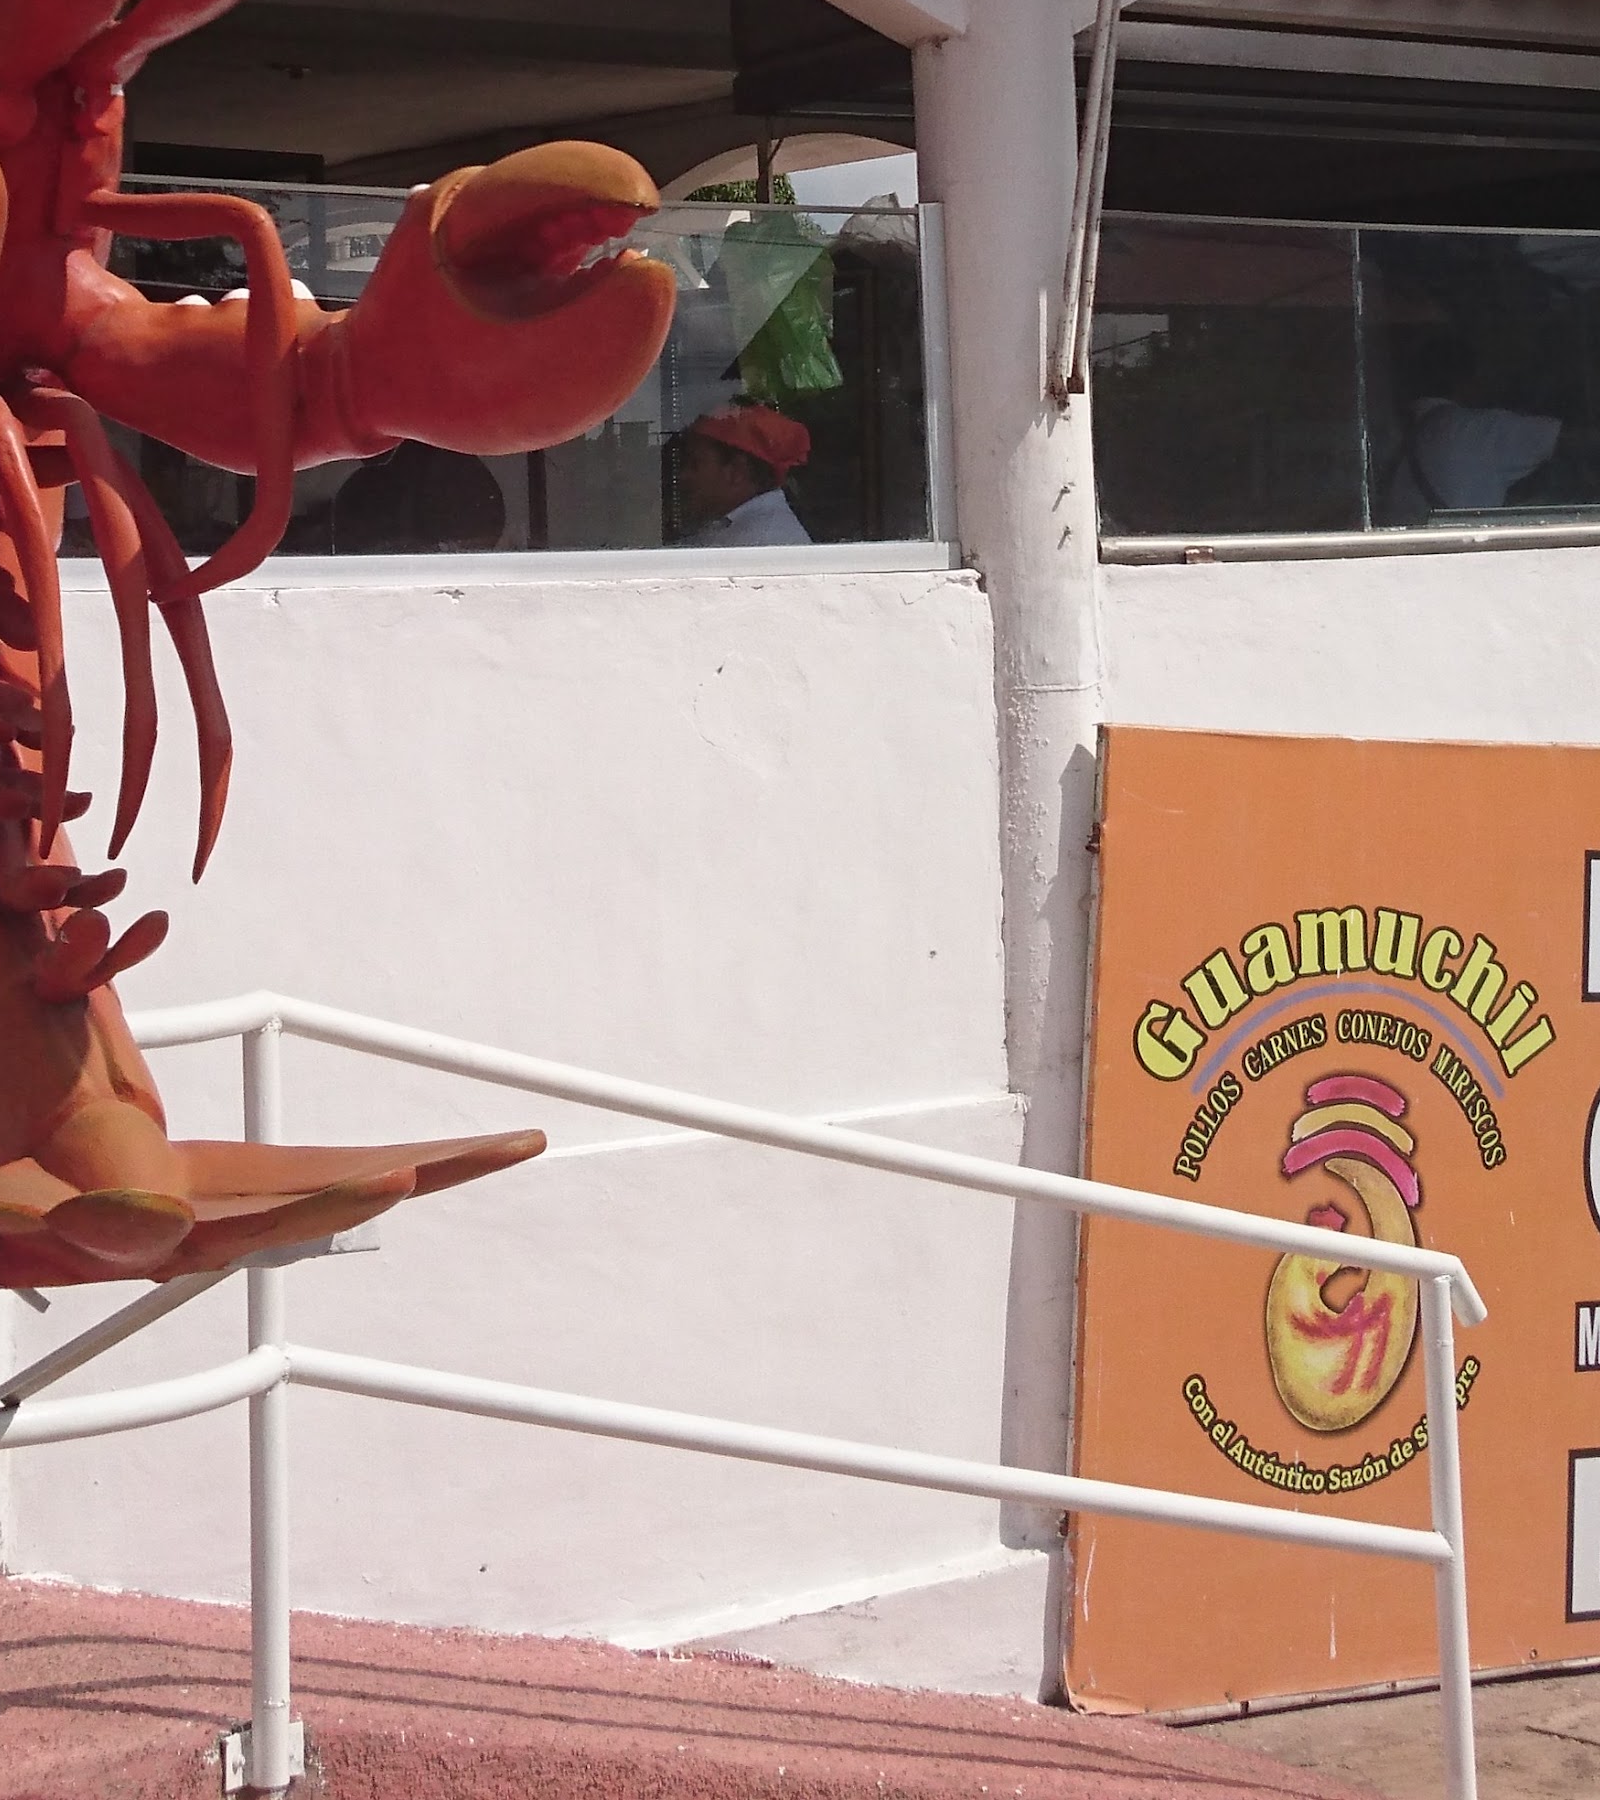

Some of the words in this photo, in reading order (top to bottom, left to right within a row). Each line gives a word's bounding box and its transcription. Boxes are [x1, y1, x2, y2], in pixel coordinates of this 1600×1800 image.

[1133, 905, 1556, 1082] Guamuchil
[1173, 1071, 1243, 1182] POLLOS
[1242, 1014, 1327, 1081] CARNES
[1336, 1009, 1432, 1059] CONEJOS
[1430, 1043, 1506, 1170] MARISCOS
[1182, 1373, 1218, 1432] Con
[1210, 1414, 1238, 1449] el
[1225, 1435, 1325, 1493] Auténtico
[1327, 1452, 1390, 1493] Sazón
[1388, 1438, 1415, 1471] de
[1411, 1355, 1481, 1452] Spre
